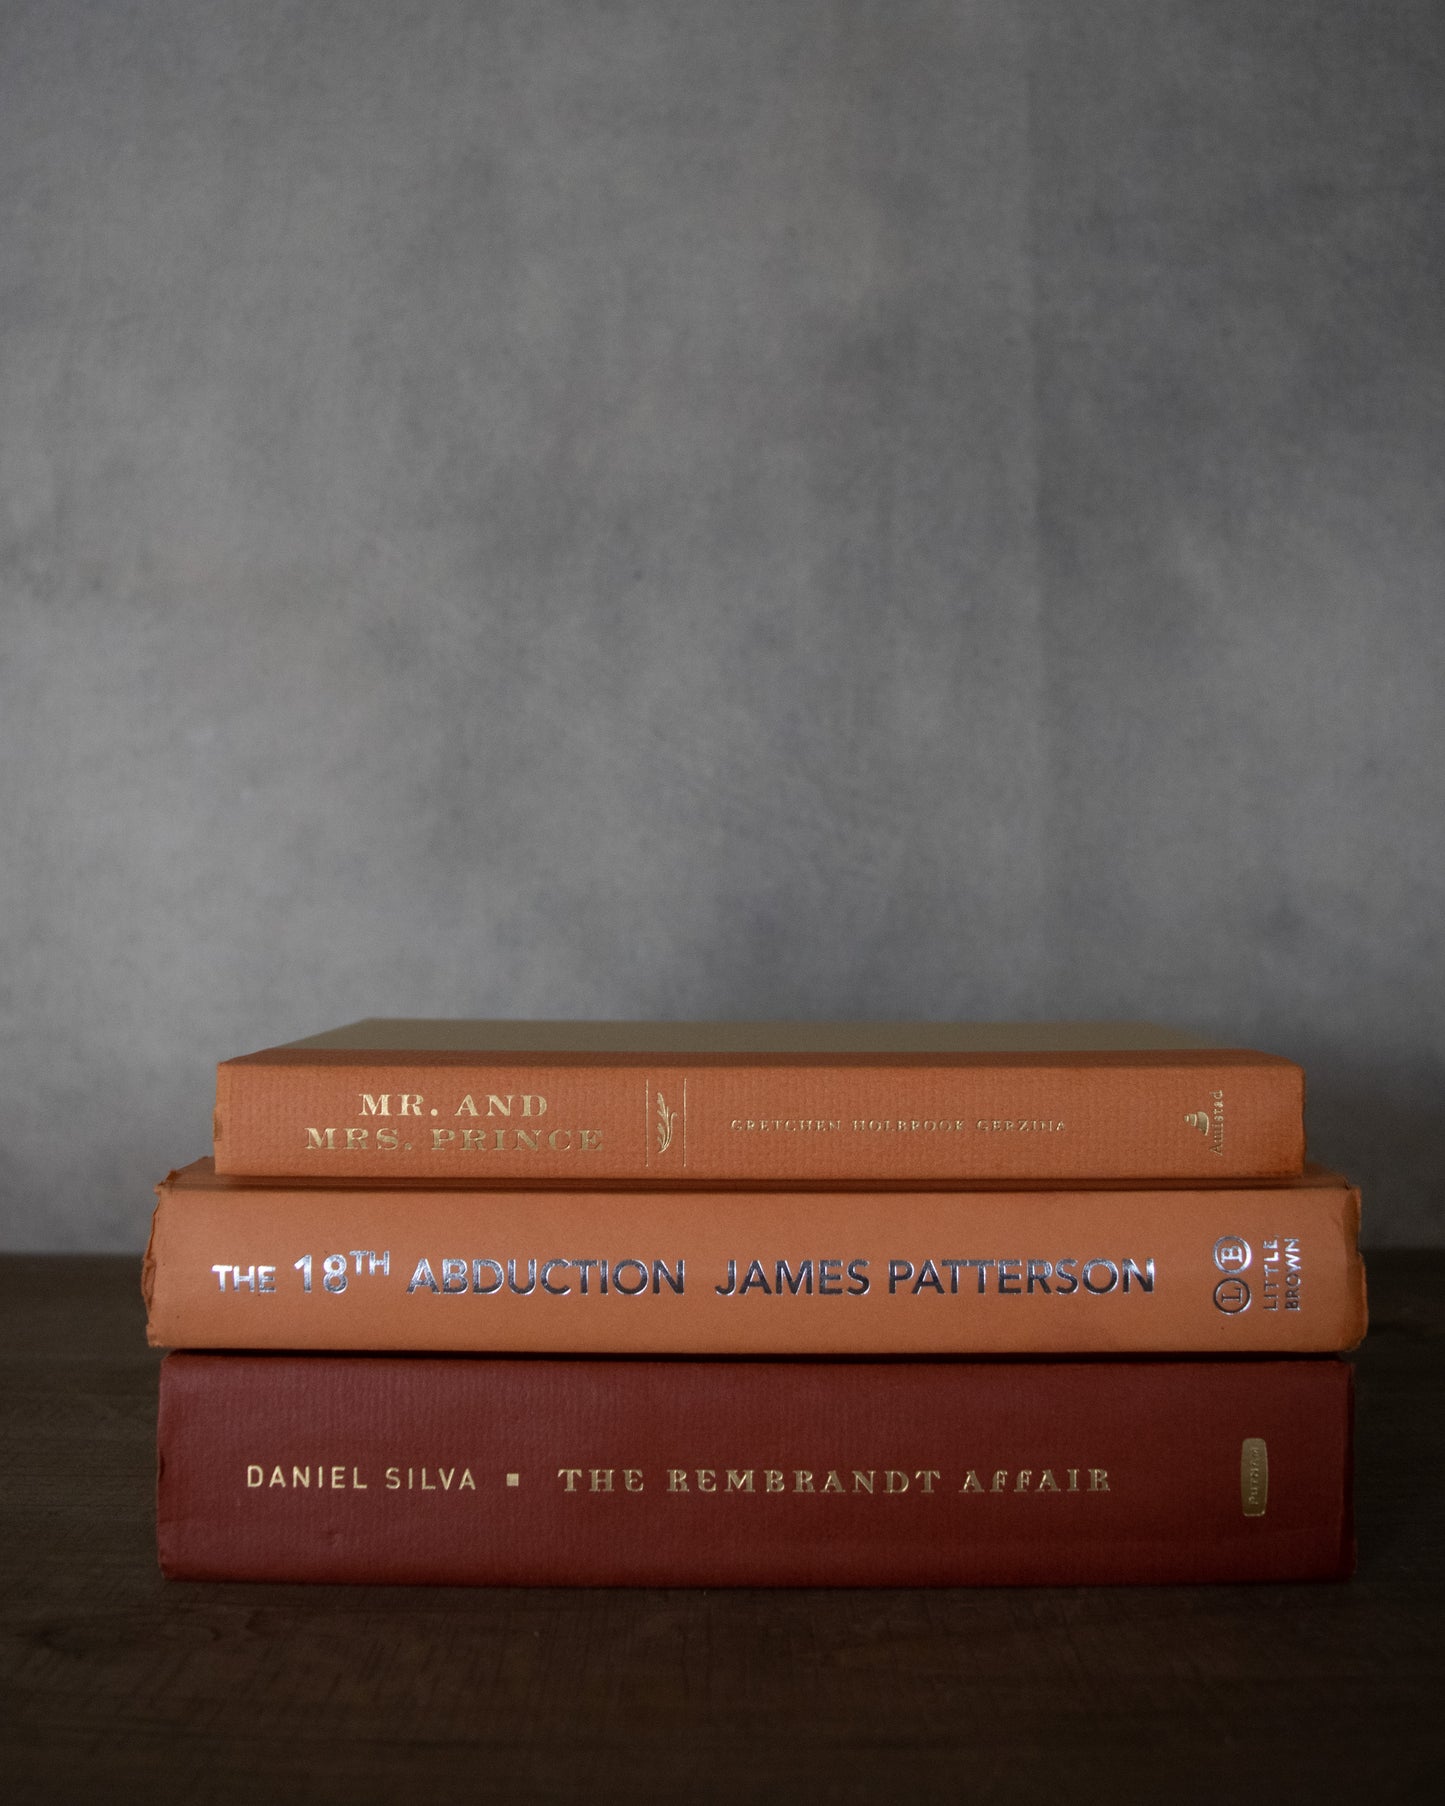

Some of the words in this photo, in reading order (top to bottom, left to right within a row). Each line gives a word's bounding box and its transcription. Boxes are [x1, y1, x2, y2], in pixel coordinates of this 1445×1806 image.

[358, 1093, 438, 1117] MR.
[454, 1093, 548, 1117] AND
[730, 1119, 842, 1132] GRETCHEN
[852, 1119, 967, 1132] HOLBROOK
[976, 1119, 1067, 1132] GERZINA
[304, 1127, 413, 1151] MRS.
[430, 1128, 604, 1152] PRINCE
[212, 1264, 277, 1293] THE
[294, 1250, 390, 1295] 18TH
[406, 1258, 686, 1296] ABDUCTION
[714, 1259, 871, 1296] JAMES
[888, 1257, 1156, 1296] PATTERSON
[1284, 1238, 1302, 1311] BROWN
[246, 1465, 369, 1489] DANIEL
[385, 1466, 477, 1491] SILVA
[557, 1468, 645, 1493] THE
[666, 1469, 941, 1494] REMBRANDT
[958, 1468, 1112, 1493] AFFAIR
